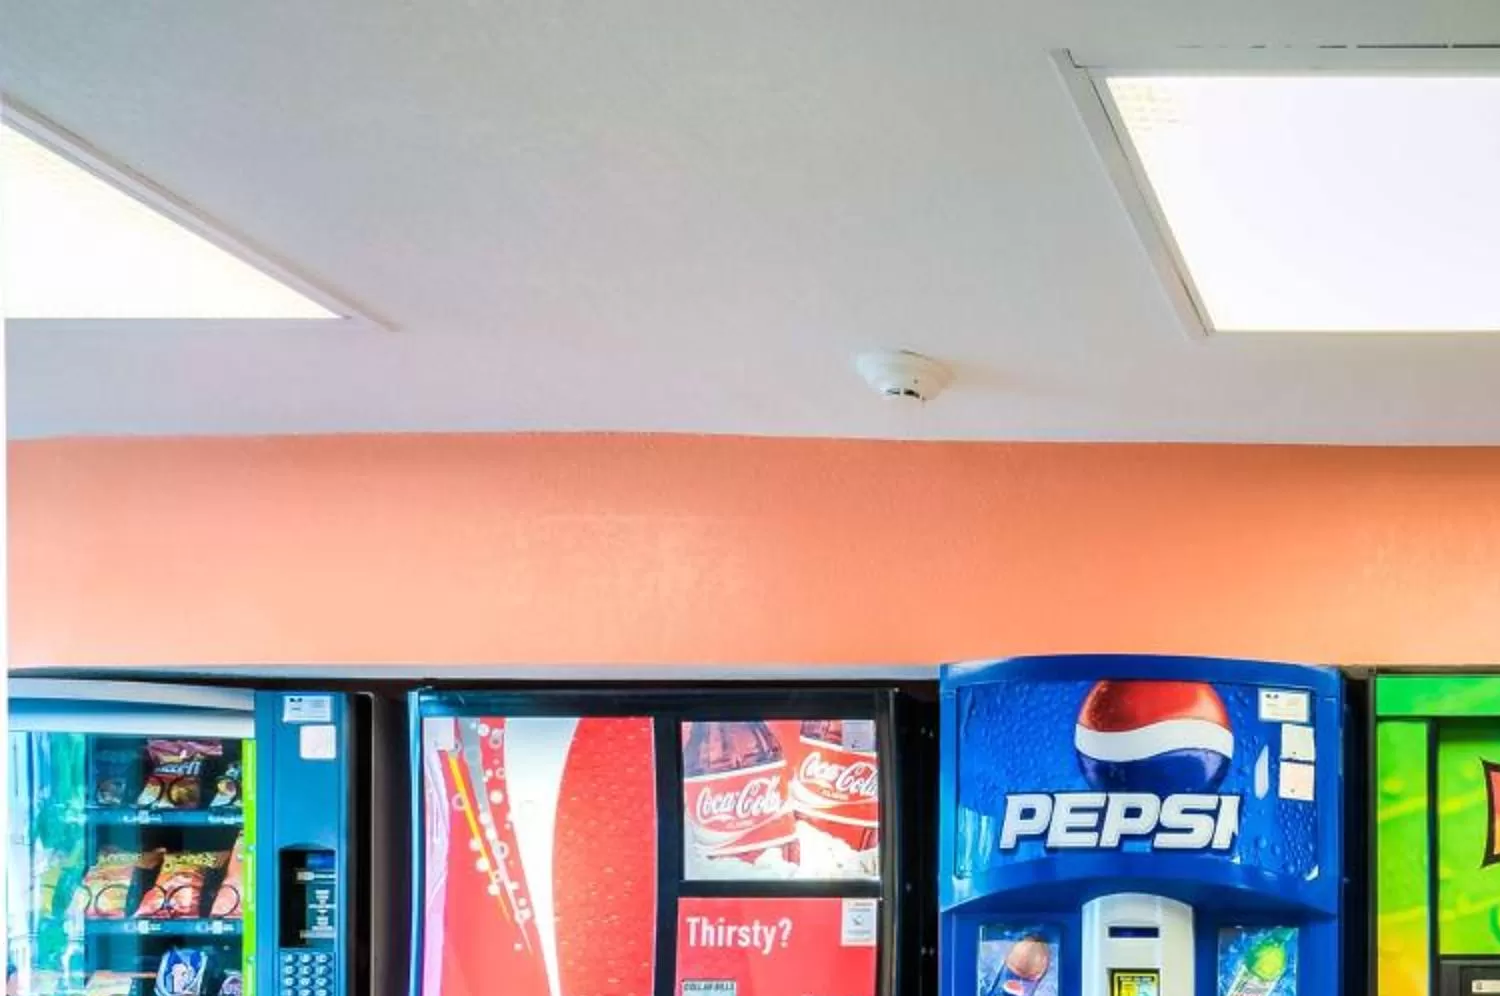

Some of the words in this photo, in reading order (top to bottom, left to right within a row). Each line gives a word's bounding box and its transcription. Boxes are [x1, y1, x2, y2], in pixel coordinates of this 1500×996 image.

[696, 776, 786, 823] Coca-Cola
[1000, 793, 1240, 849] PEPSI
[685, 914, 794, 955] Thirsty?
